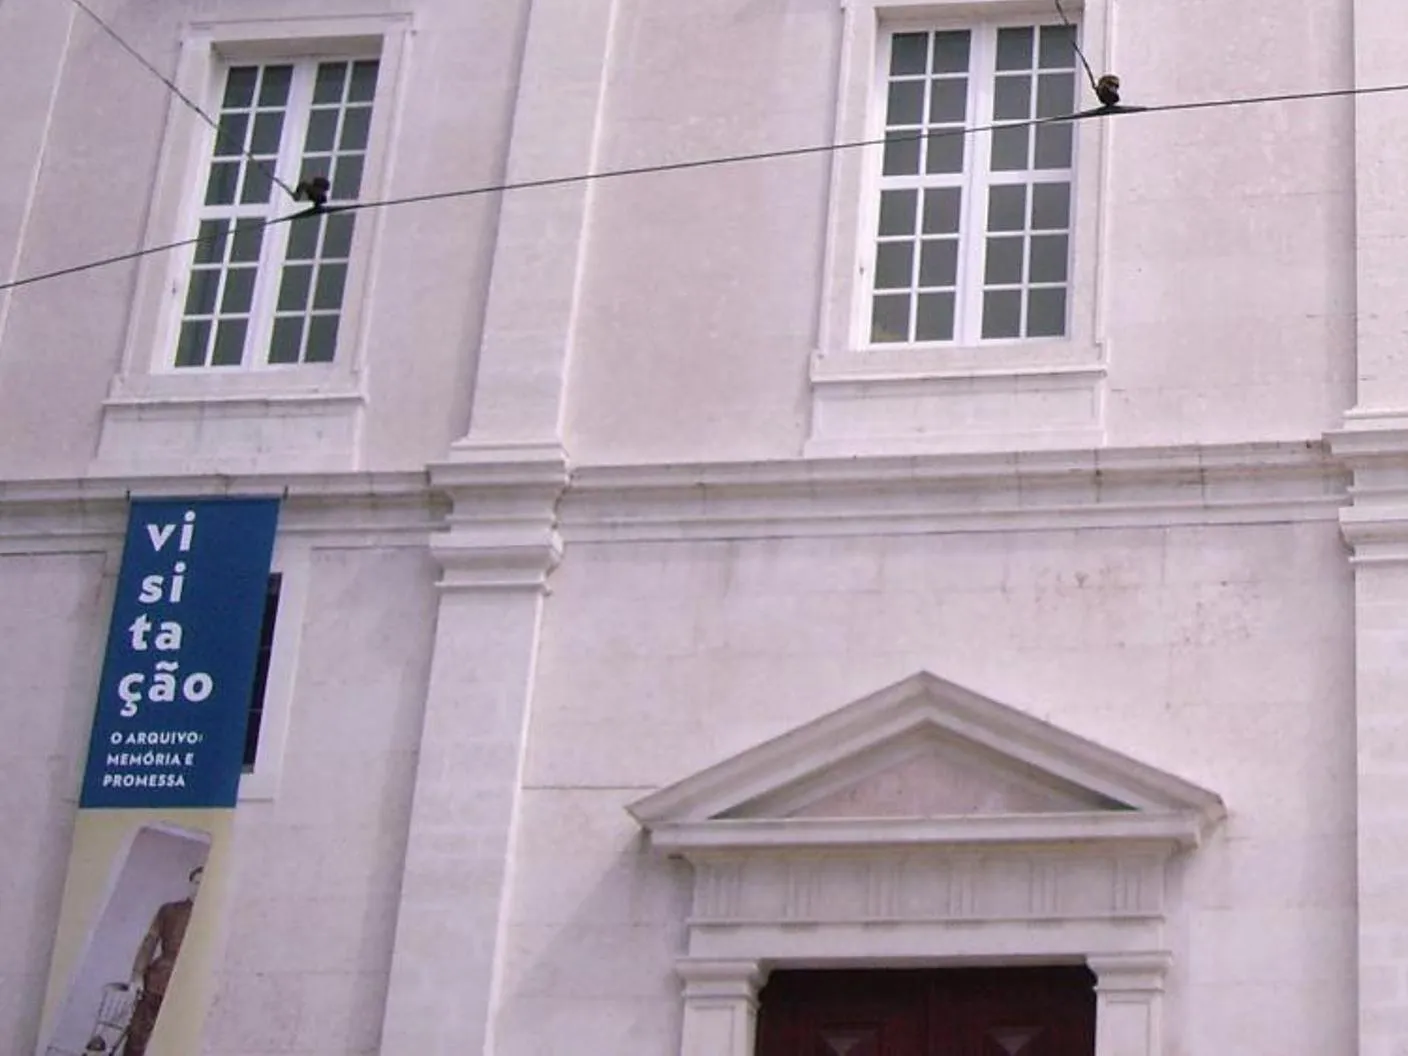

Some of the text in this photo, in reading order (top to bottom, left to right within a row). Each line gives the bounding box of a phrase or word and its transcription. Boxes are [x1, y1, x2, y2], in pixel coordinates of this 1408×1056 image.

[117, 660, 214, 718] ção
[110, 732, 123, 745] O
[106, 750, 195, 766] MEMÓRIA E
[102, 774, 186, 788] PROMESSA
